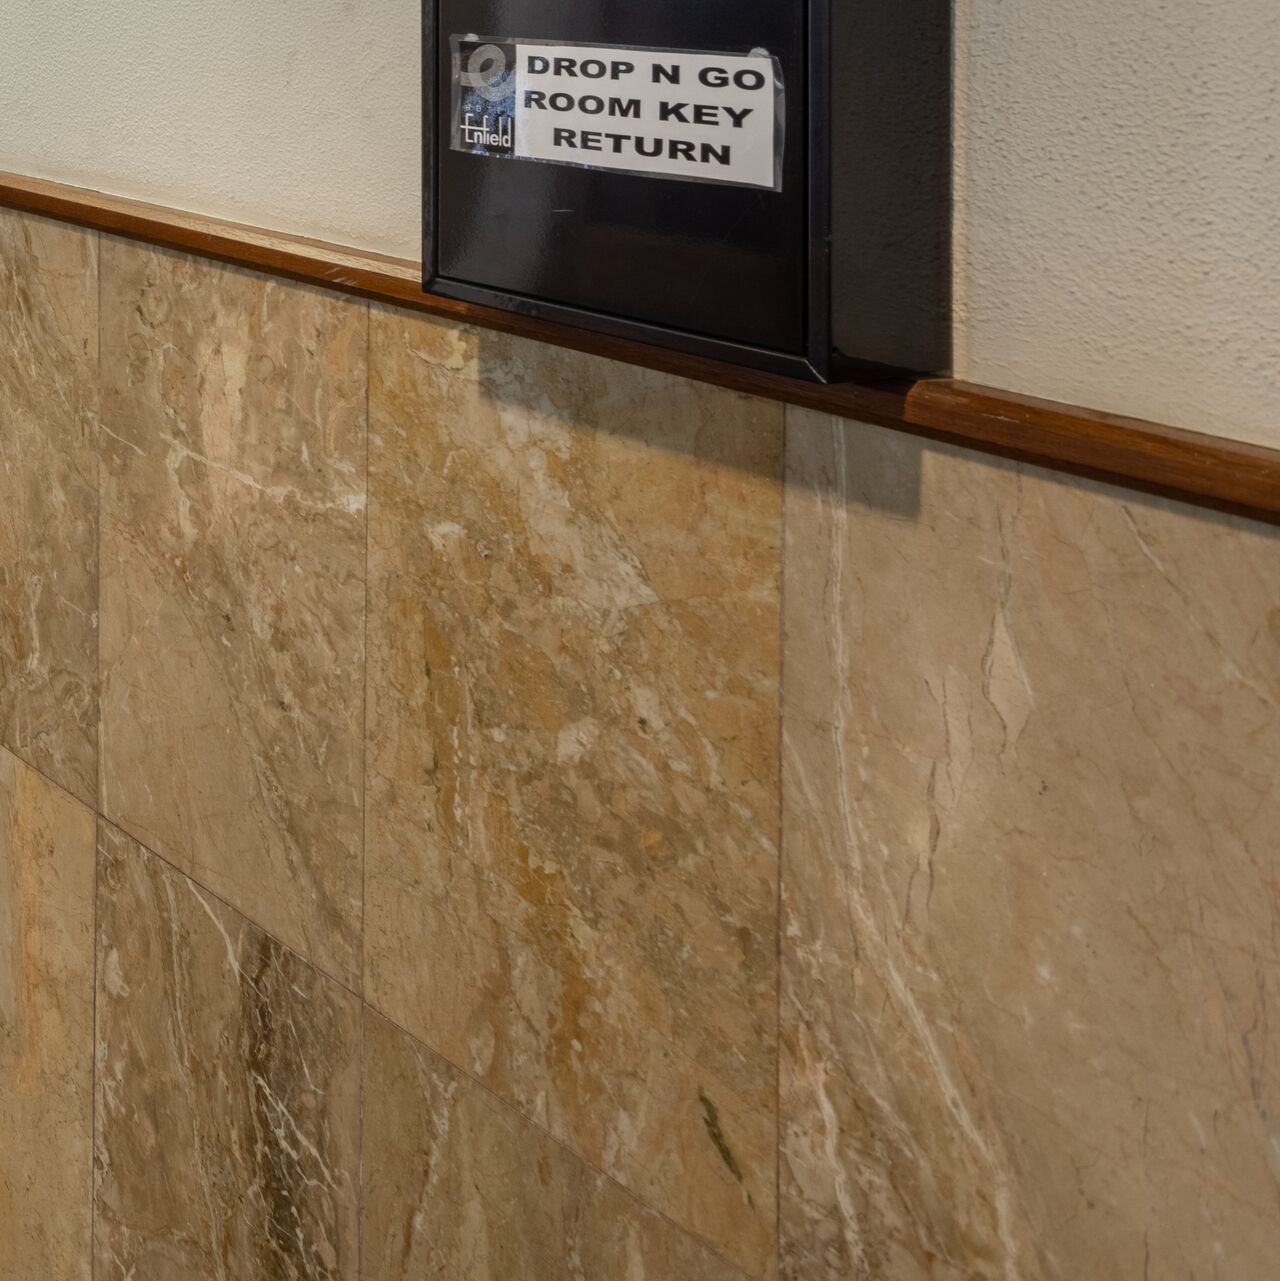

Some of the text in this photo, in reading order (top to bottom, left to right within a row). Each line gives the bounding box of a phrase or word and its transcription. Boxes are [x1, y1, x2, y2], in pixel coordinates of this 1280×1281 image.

[527, 55, 766, 91] DROP N GO
[524, 89, 755, 128] ROOM KEY
[459, 112, 512, 148] Enfield
[553, 127, 731, 166] RETURN
